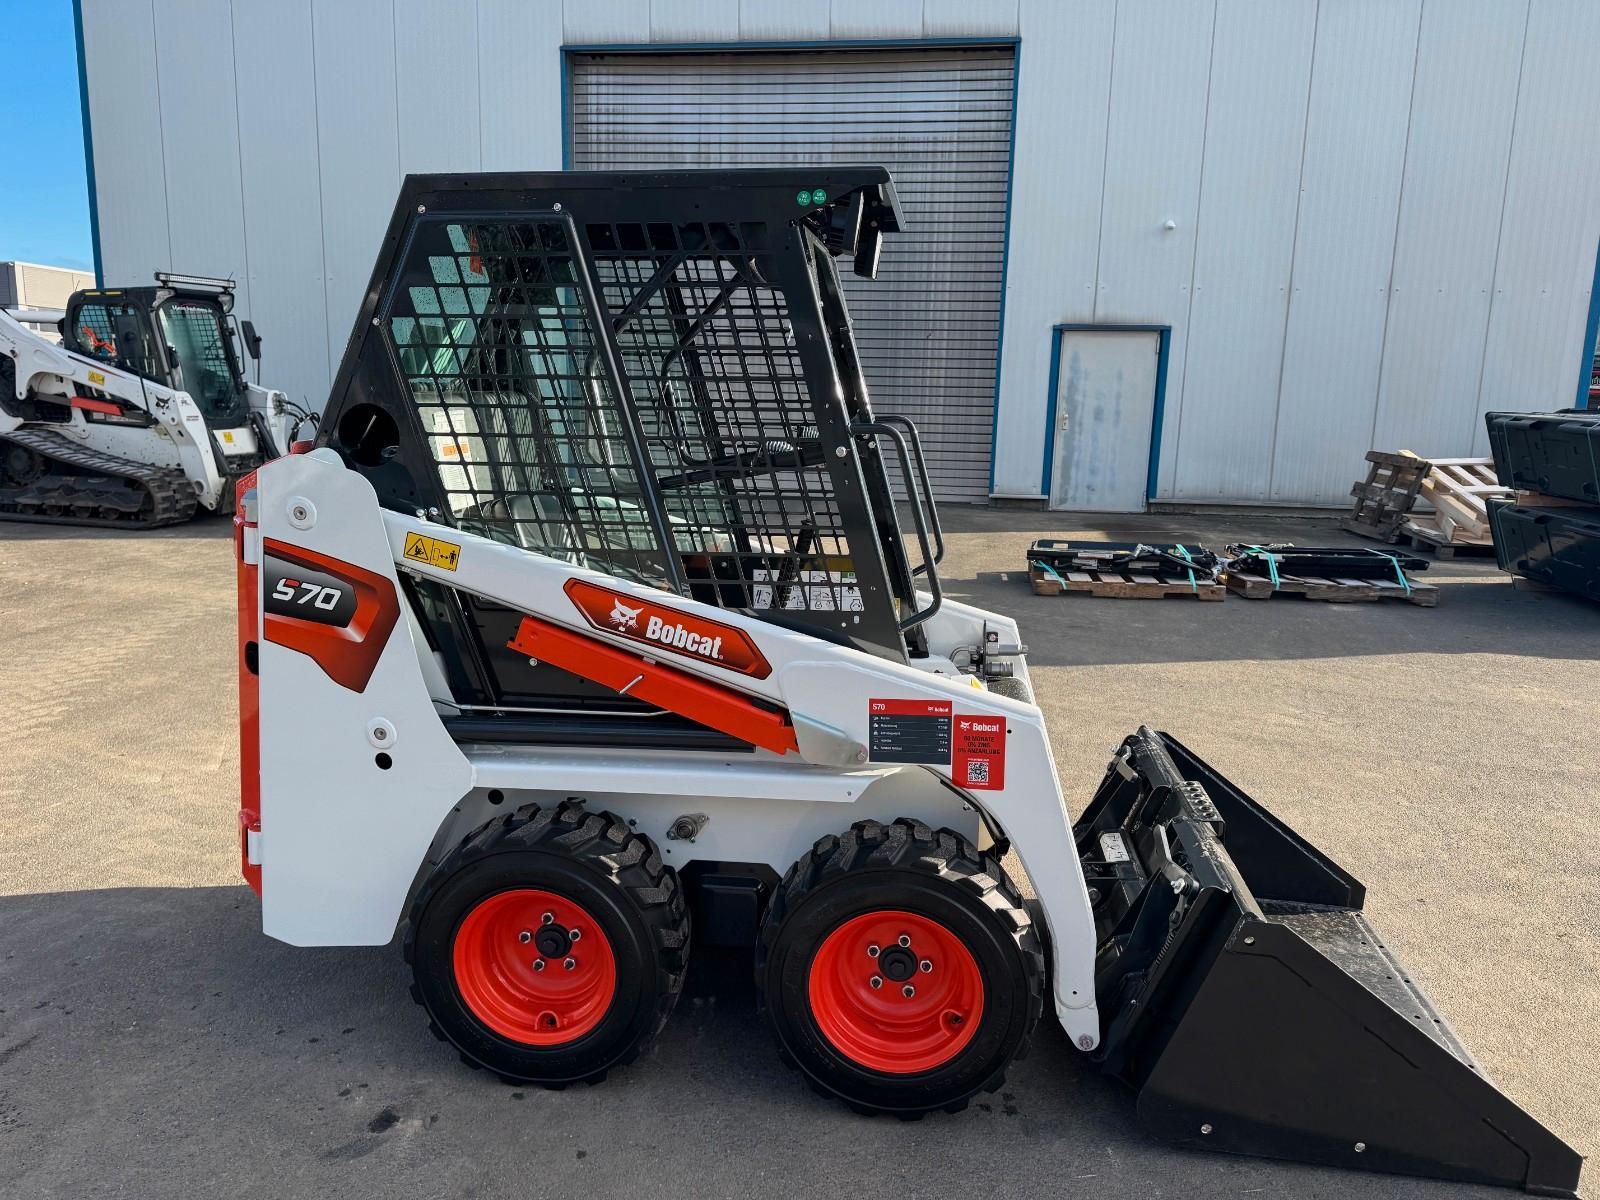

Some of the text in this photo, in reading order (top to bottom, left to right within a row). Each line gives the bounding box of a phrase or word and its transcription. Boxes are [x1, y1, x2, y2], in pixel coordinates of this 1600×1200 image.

[272, 578, 342, 611] S70
[645, 615, 723, 660] Bobcat
[872, 703, 886, 711] S70
[972, 722, 1000, 733] Bobcat
